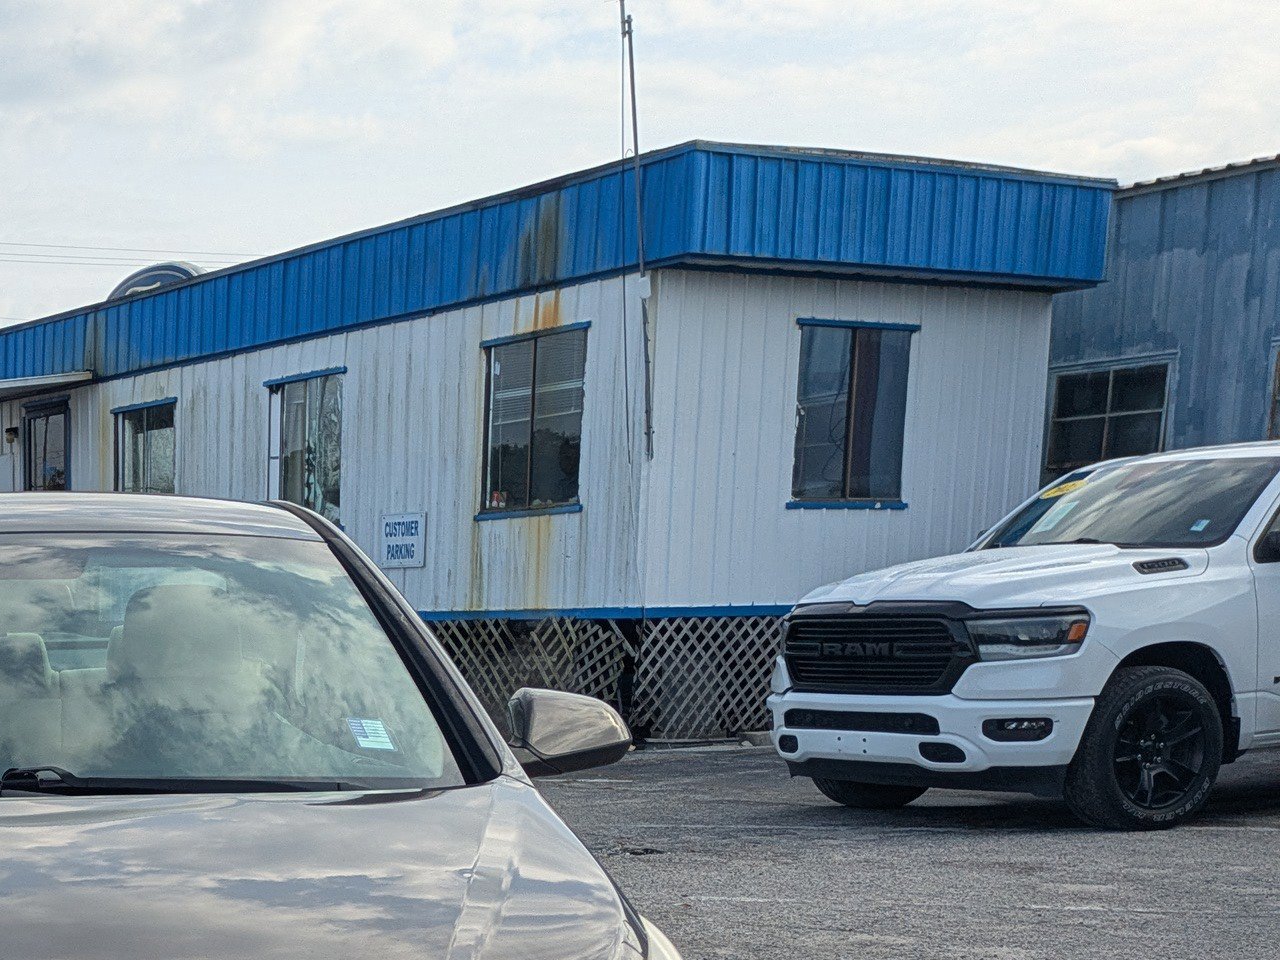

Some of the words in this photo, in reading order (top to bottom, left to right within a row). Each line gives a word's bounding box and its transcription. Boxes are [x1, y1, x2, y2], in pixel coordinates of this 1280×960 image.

[384, 520, 419, 537] CUSTOMER
[386, 543, 415, 560] PARKING
[822, 642, 890, 656] RAM
[1115, 681, 1207, 730] BRIDGESTONE
